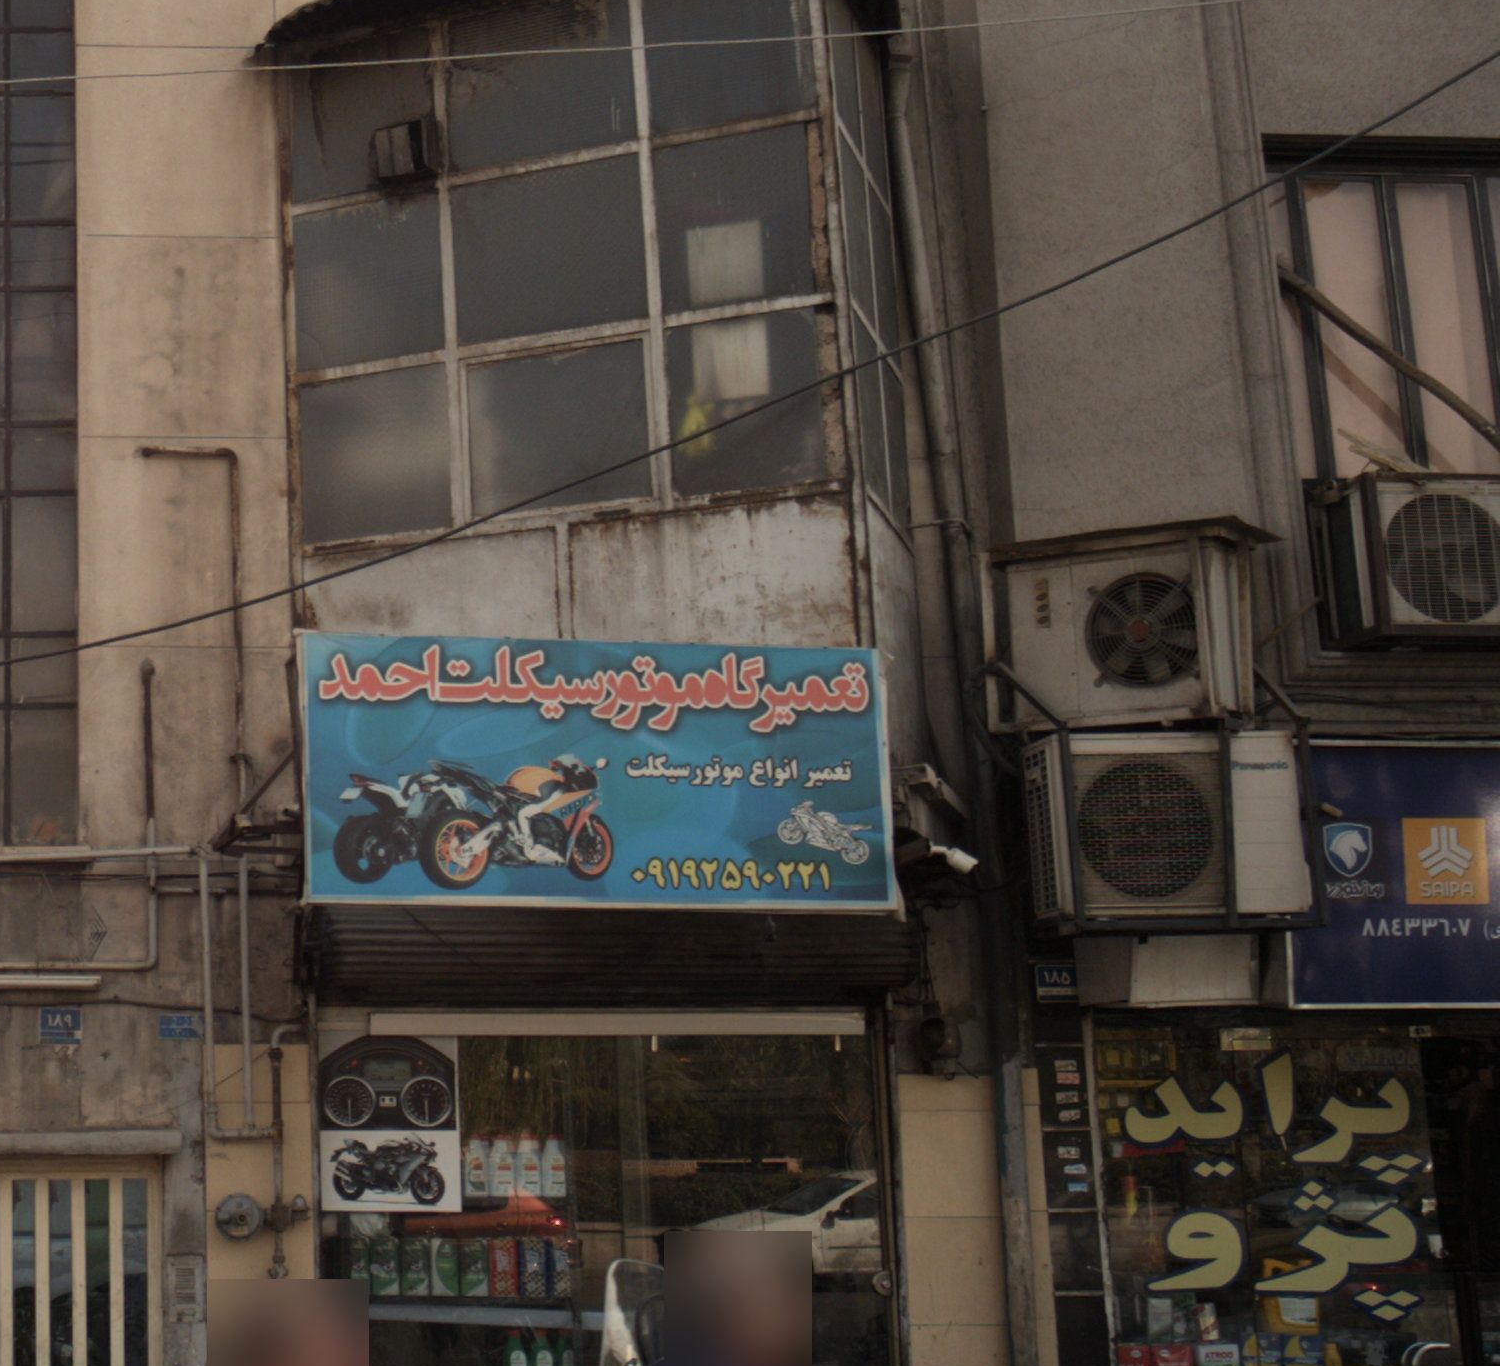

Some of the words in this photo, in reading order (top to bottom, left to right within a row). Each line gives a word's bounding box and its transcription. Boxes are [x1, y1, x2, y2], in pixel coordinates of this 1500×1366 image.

[319, 644, 440, 701] احمد
[703, 651, 871, 733] تعمیرگاه
[747, 757, 799, 788] انواع
[803, 761, 853, 788] تعمیر
[630, 857, 833, 892] ۰۹۱۹۲۵۹۰۲۲۱
[1419, 880, 1476, 899] SAIPA
[1043, 969, 1072, 985] ۱۸۵
[1123, 1046, 1427, 1186] پراید
[1147, 1179, 1423, 1322] پژو
